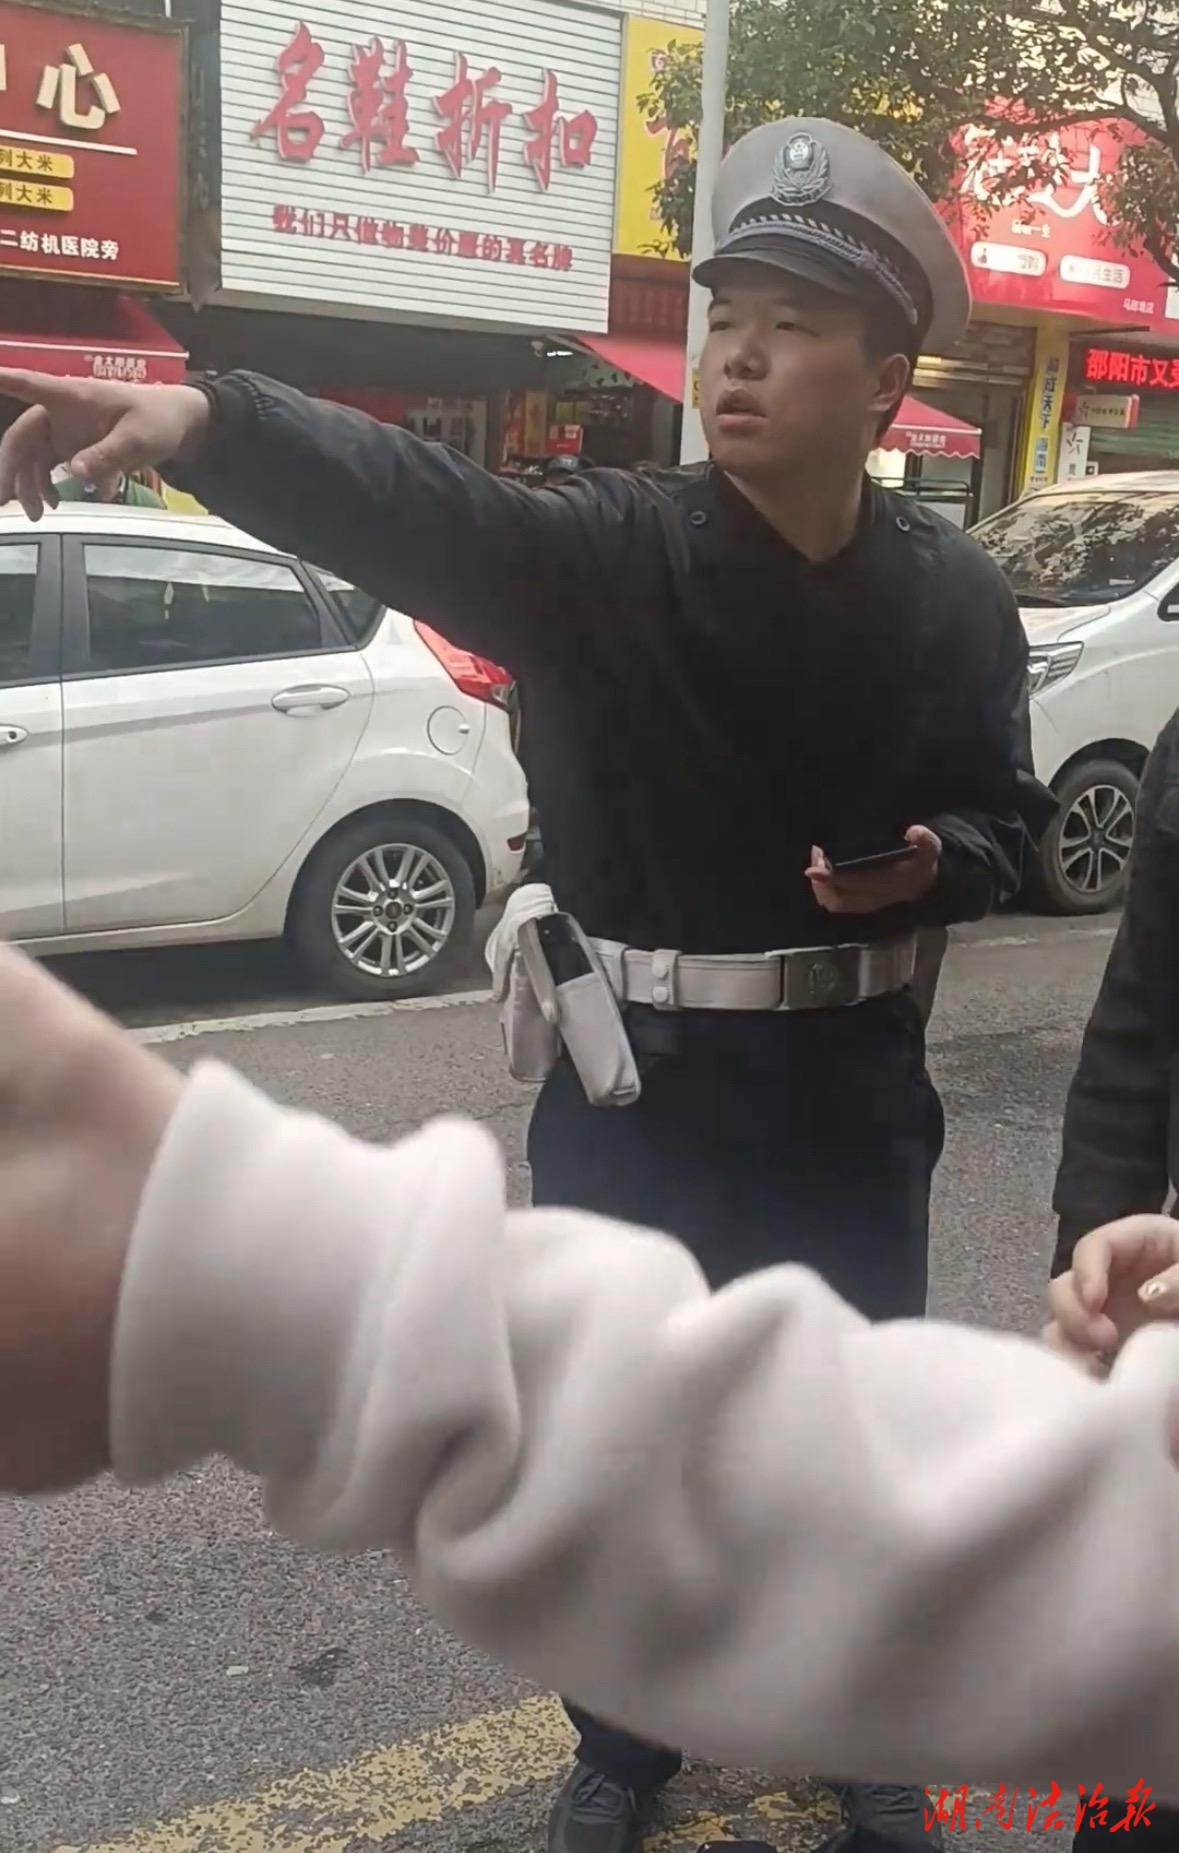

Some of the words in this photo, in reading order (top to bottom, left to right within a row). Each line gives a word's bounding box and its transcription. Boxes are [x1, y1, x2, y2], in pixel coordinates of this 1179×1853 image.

[0, 40, 121, 130] 心
[251, 21, 598, 194] 名鞋折扣
[0, 228, 119, 260] 二纺机医院旁
